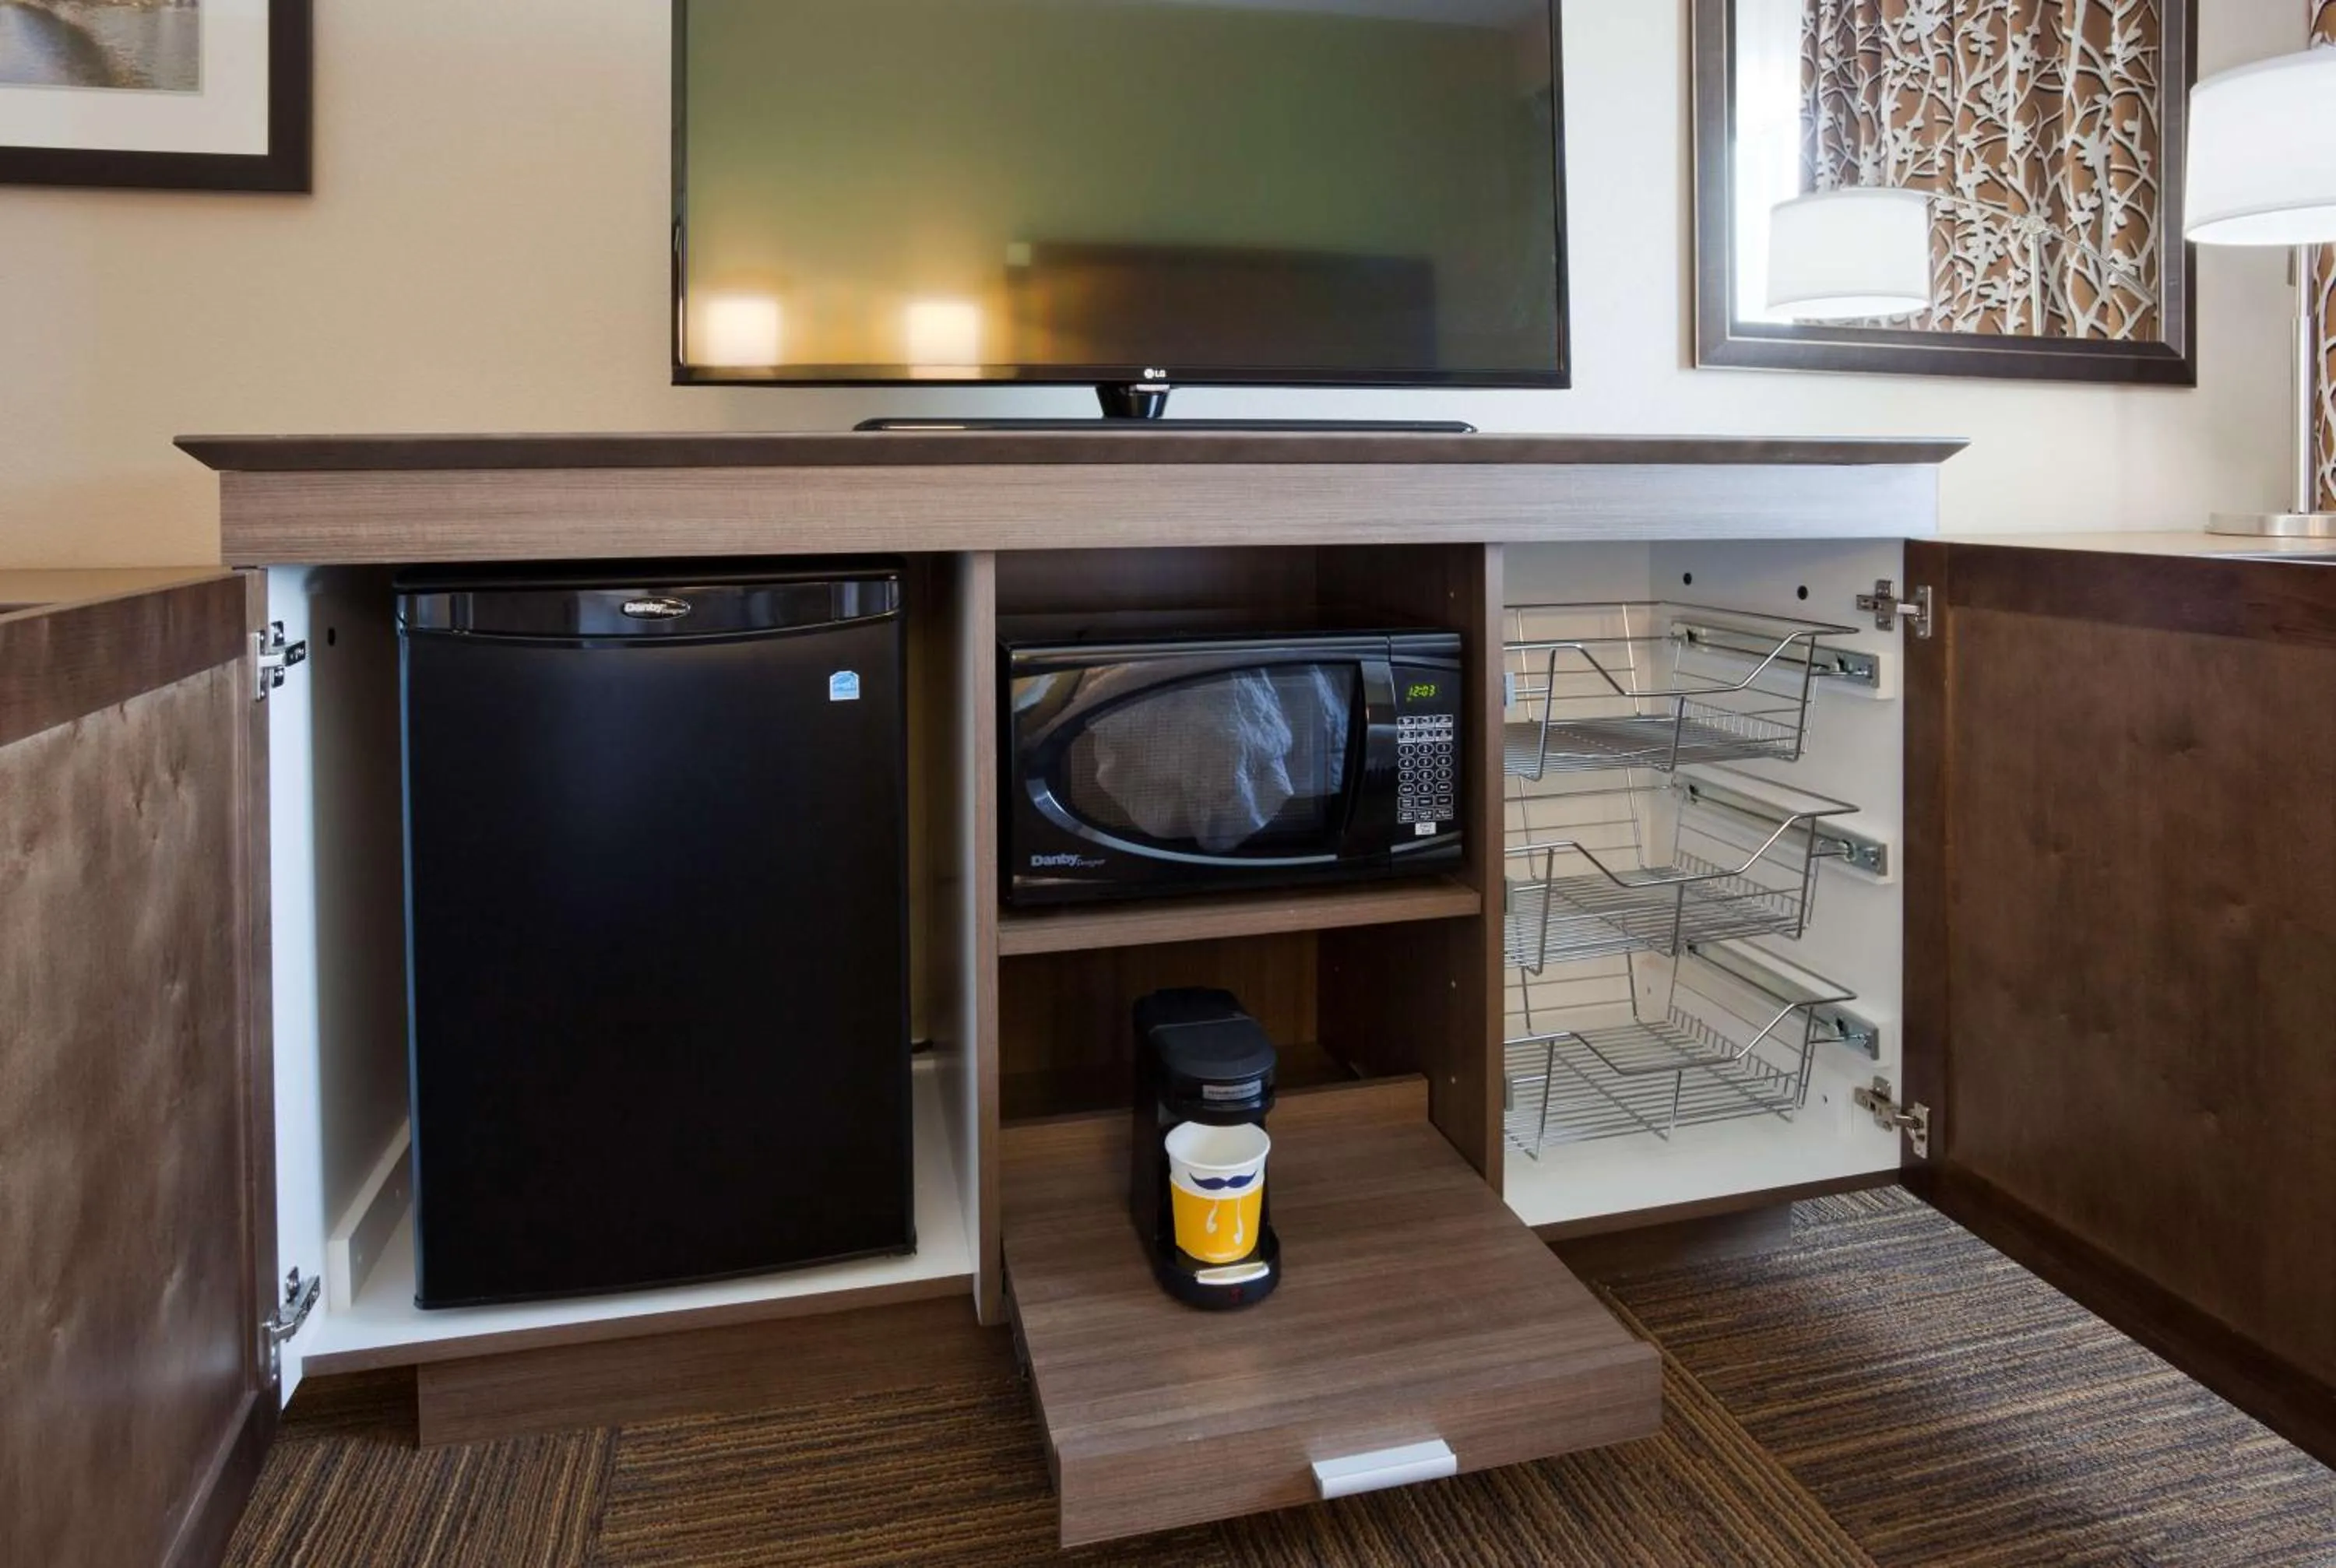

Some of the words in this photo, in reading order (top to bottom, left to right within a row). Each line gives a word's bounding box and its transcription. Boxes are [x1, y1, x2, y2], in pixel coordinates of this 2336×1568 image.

[624, 602, 666, 613] Danby
[1409, 684, 1436, 697] 12:03
[1031, 853, 1080, 867] Danby
